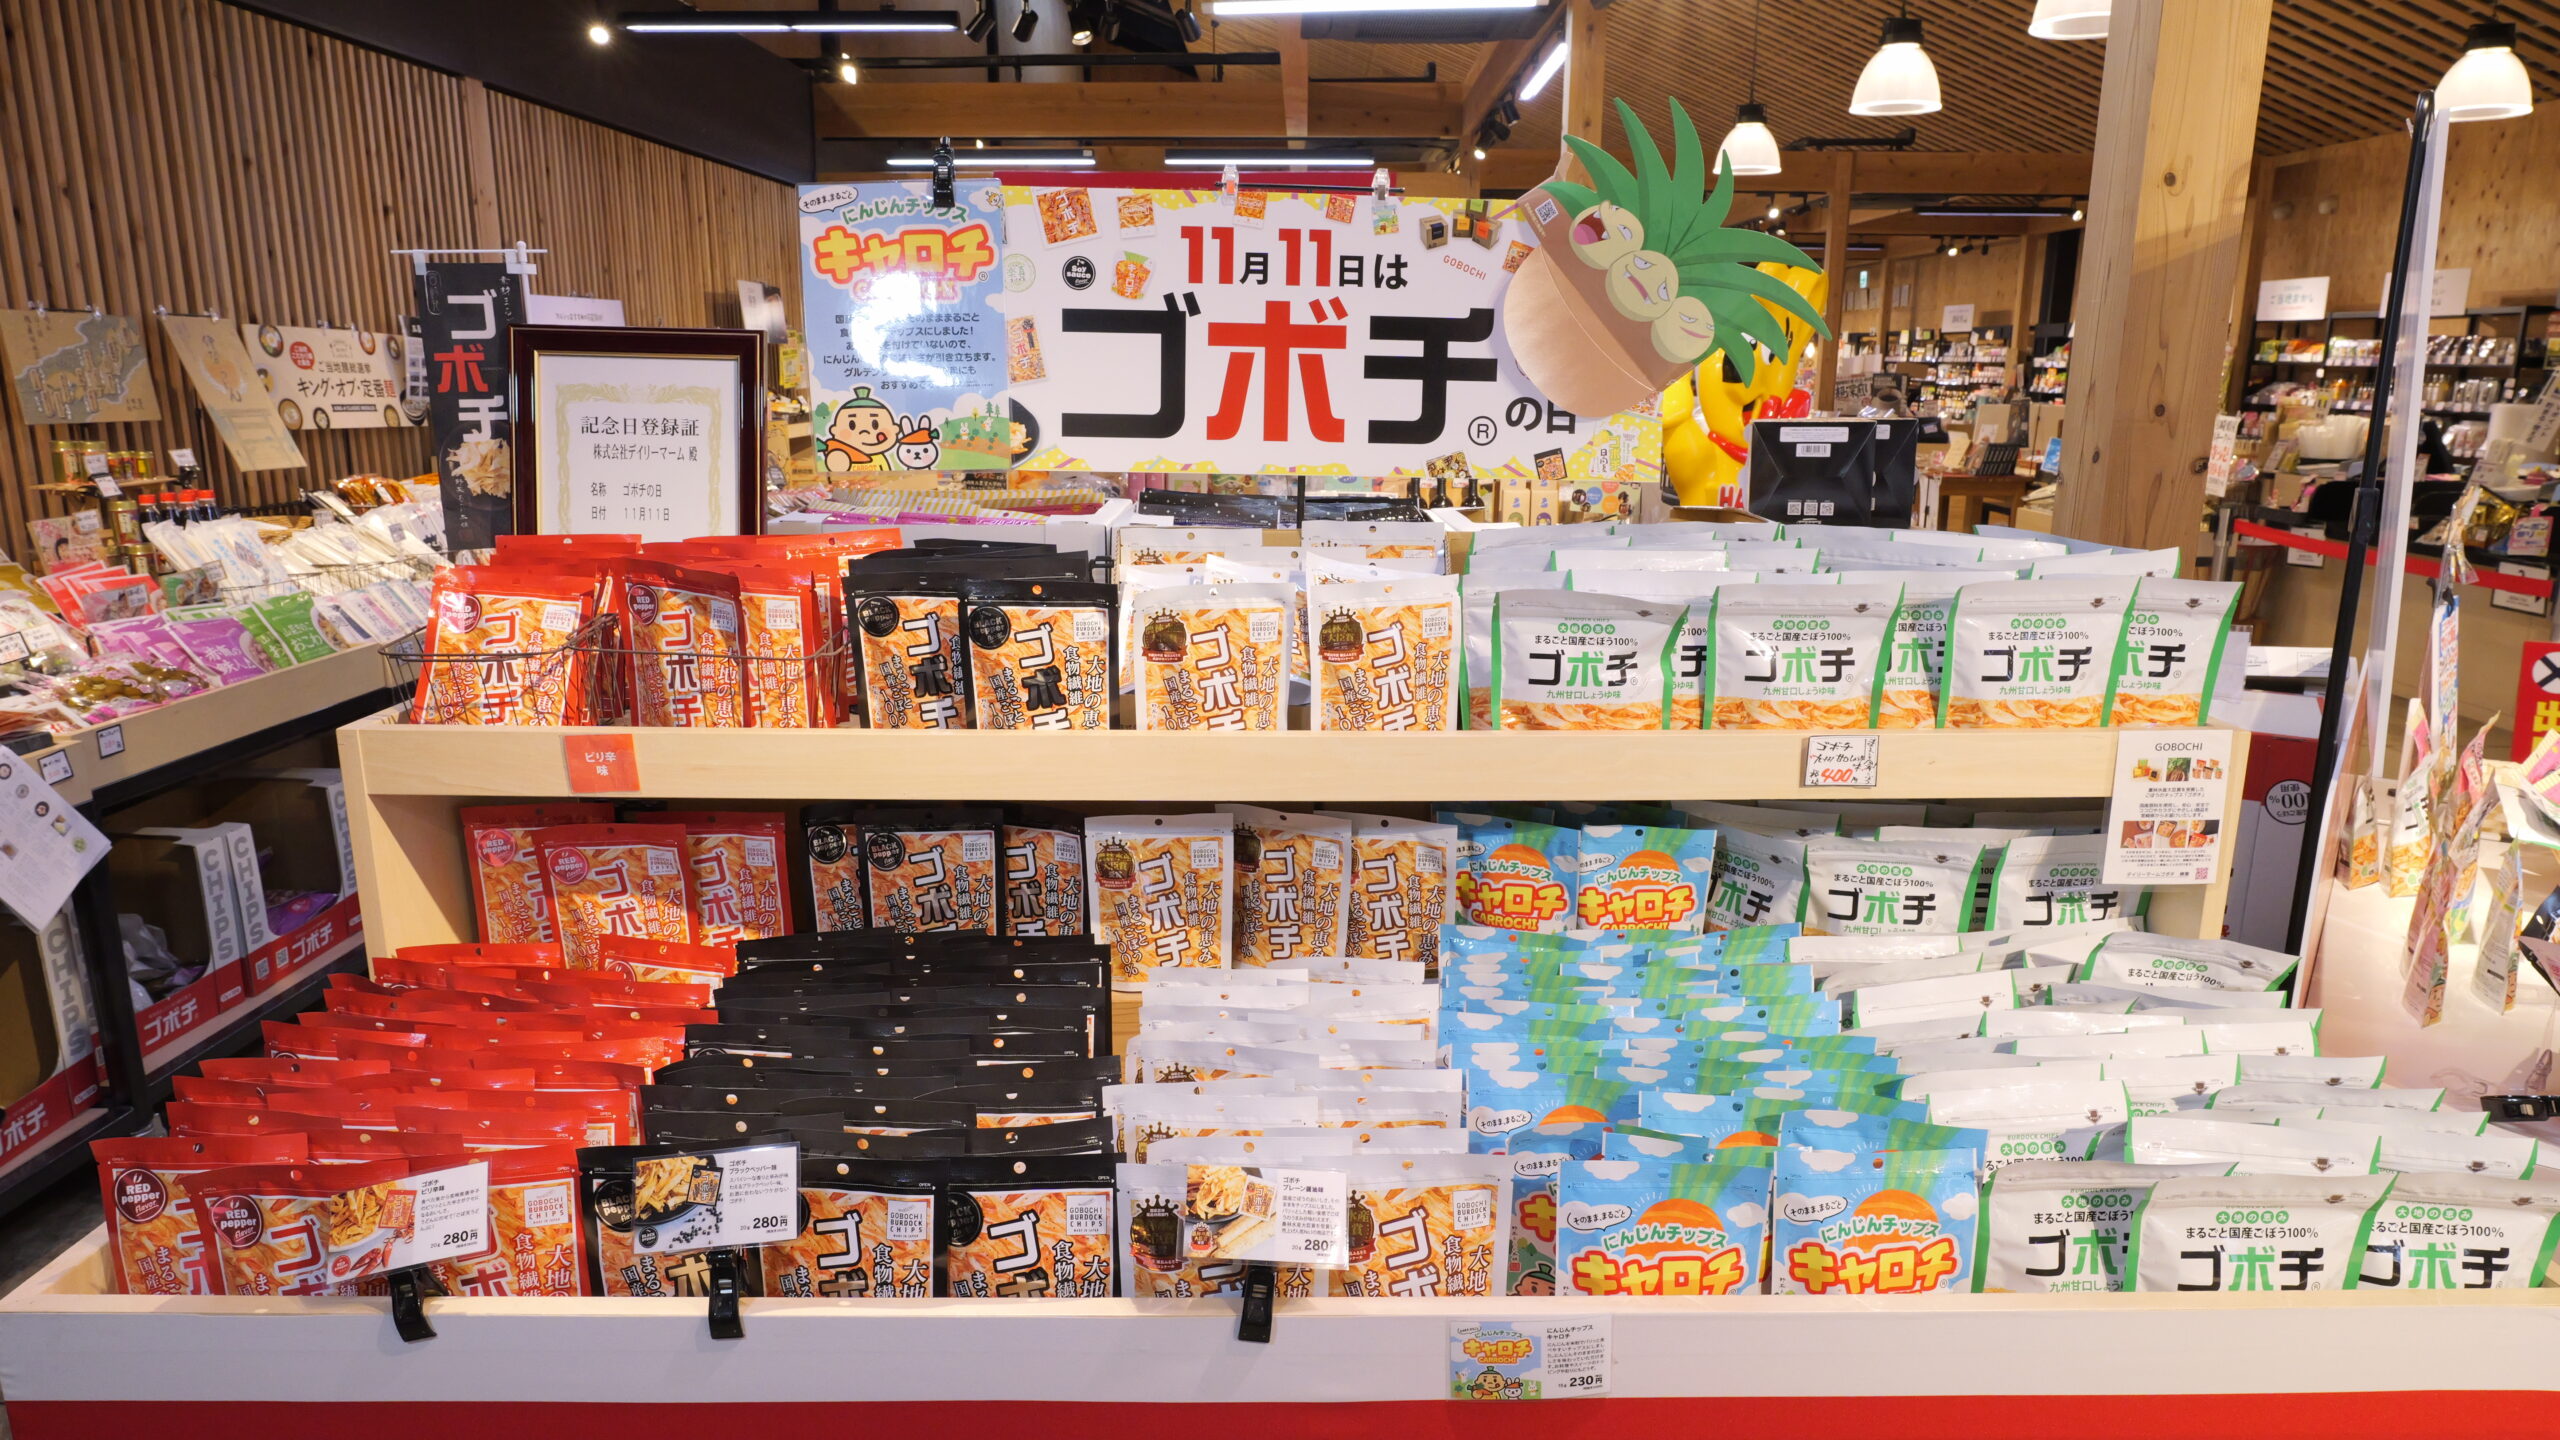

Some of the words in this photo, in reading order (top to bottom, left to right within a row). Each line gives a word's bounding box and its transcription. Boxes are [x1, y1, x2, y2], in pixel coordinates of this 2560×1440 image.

[813, 226, 995, 283] キャロチ
[1443, 255, 1486, 280] GOBOCHI
[433, 288, 508, 443] ゴボチ
[1061, 291, 1498, 443] ゴボチ
[581, 416, 700, 437] 記念日登録証
[591, 482, 607, 497] 名称
[622, 483, 662, 498] ゴボチの日
[591, 506, 607, 521] 日付
[635, 595, 650, 604] RED
[1424, 616, 1449, 624] GOBOCHI
[1534, 635, 1638, 647] まるごと国産ごぼう100%
[1749, 632, 1851, 642] まるごと国産ごぼう100%
[1988, 631, 2089, 641] まるごと国産ごぼう100%
[902, 612, 958, 729] ゴボチ
[1413, 642, 1427, 700] 食物繊維
[1528, 649, 1638, 686] ゴボチ
[1743, 645, 1855, 683] ゴボチ
[1981, 645, 2092, 682] ゴボチ
[1063, 646, 1083, 706] 食物繊維
[1240, 646, 1258, 707] 食物繊維
[1546, 690, 1622, 699] 九州甘口しょうゆ味
[1762, 686, 1837, 696] 九州甘口しょうゆ味
[1999, 686, 2072, 696] 九州甘口しょうゆ味
[2155, 742, 2204, 752] GOBOCHI
[596, 765, 609, 777] 味
[1821, 768, 1853, 782] 400
[482, 844, 511, 856] pepper
[486, 839, 504, 848] RED
[812, 835, 840, 846] BLACK
[871, 844, 897, 853] BLACK
[558, 856, 576, 865] RED
[873, 850, 899, 858] pepper
[552, 861, 583, 872] pepper
[1468, 860, 1552, 882] にんじんチップス
[1596, 864, 1682, 885] にんじんチップス
[232, 836, 265, 944] CHIPS
[1833, 873, 1934, 888] まるごと国産ごぼう100%
[738, 868, 758, 922] 食物繊維
[954, 864, 973, 921] 食物繊維
[1045, 863, 1060, 920] 食物繊維
[1183, 872, 1201, 928] 食物繊維
[1302, 868, 1318, 924] 食物繊維
[1407, 874, 1423, 929] 食物繊維
[1455, 870, 1568, 921] キャロチ
[201, 848, 234, 960] CHIPS
[640, 880, 662, 935] 食物繊維
[1138, 852, 1191, 968] ゴボチ
[1264, 846, 1301, 959] ゴボチ
[1363, 854, 1411, 961] ゴボチ
[1578, 884, 1696, 924] キャロチ
[1827, 888, 1937, 925] ゴボチ
[2023, 890, 2119, 926] ゴボチ
[1128, 894, 1149, 946] まるごと
[1198, 881, 1221, 964] 大地の恵み
[1312, 882, 1339, 958] 大地の恵み
[1418, 885, 1445, 966] 大地の恵み
[1471, 909, 1539, 931] CARROCHI
[292, 922, 333, 962] ゴボチ
[2127, 967, 2225, 988] まるごと国産ごぼう100%
[46, 928, 88, 1056] CHIPS
[144, 997, 198, 1046] ゴボチ
[1480, 1114, 1528, 1128] そのまま、まるごと
[121, 1190, 161, 1204] pepper
[126, 1184, 151, 1195] RED
[528, 1197, 564, 1207] GOBOCHI
[528, 1204, 564, 1213] BURDOCK
[1070, 1206, 1102, 1214] GOBOCHI
[1456, 1200, 1488, 1209] GOBOCHI
[1457, 1207, 1488, 1215] BURDOCK
[1790, 1200, 1844, 1216] そのまま、まるごと
[220, 1218, 257, 1228] pepper
[224, 1209, 248, 1219] RED
[529, 1210, 564, 1220] CHIPS
[753, 1216, 778, 1229] 280
[780, 1219, 788, 1227] 円
[890, 1212, 923, 1220] GOBOCHI
[1457, 1214, 1488, 1222] CHIPS
[1573, 1208, 1626, 1224] そのまま、まるごと
[443, 1231, 468, 1245] 280
[470, 1232, 478, 1240] 円
[1603, 1224, 1729, 1252] にんじんチップス
[1821, 1216, 1940, 1244] にんじんチップス
[2185, 1227, 2319, 1240] まるごと国産ごぼう100%
[1305, 1239, 1329, 1251] 280
[1788, 1237, 1961, 1294] キャロチ
[2177, 1245, 2324, 1292] ゴボチ
[2360, 1239, 2510, 1289] ゴボチ
[1547, 1325, 1593, 1333] にんじんチップス
[1463, 1339, 1532, 1358] キャロチ
[1570, 1376, 1594, 1387] 230
